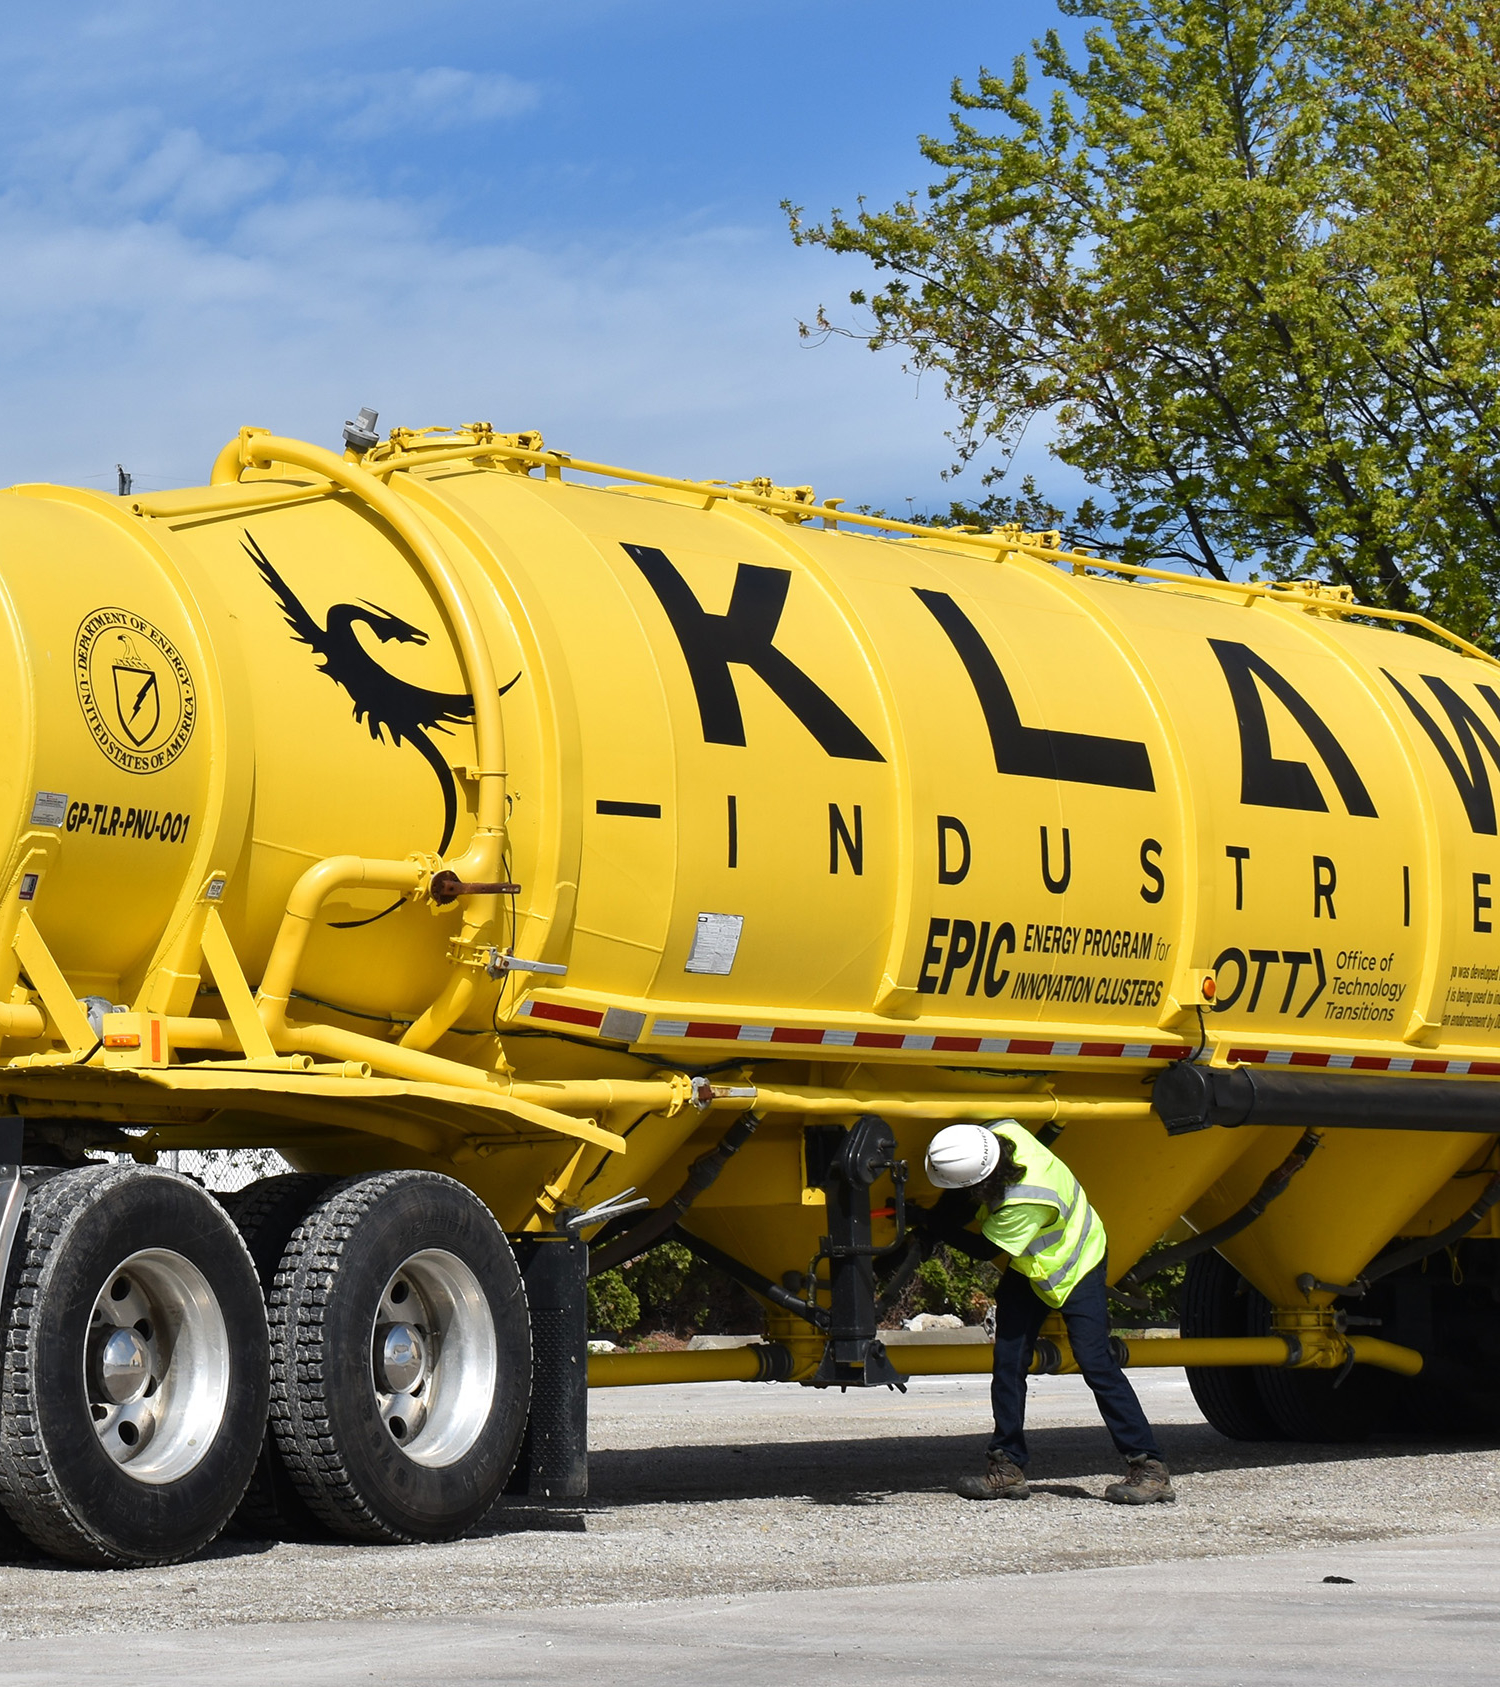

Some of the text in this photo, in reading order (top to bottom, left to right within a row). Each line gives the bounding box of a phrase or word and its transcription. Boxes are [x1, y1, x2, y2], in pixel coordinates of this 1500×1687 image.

[77, 612, 191, 686] DEPARTMENT OF ENERGY
[619, 541, 1500, 836] KLAW
[79, 680, 193, 770] UNITED STATES OF AMERICA
[66, 801, 190, 844] GP-TLR-PNU-001
[917, 917, 1016, 998] EPIC
[1023, 923, 1172, 962] ENERGY PROGRAM for
[1336, 950, 1395, 973] Office of
[1010, 972, 1164, 1008] INNOVATION CLUSTERS
[1331, 976, 1406, 1001] Technology
[1324, 1002, 1395, 1022] Transitions
[1450, 1011, 1487, 1028] endorsement
